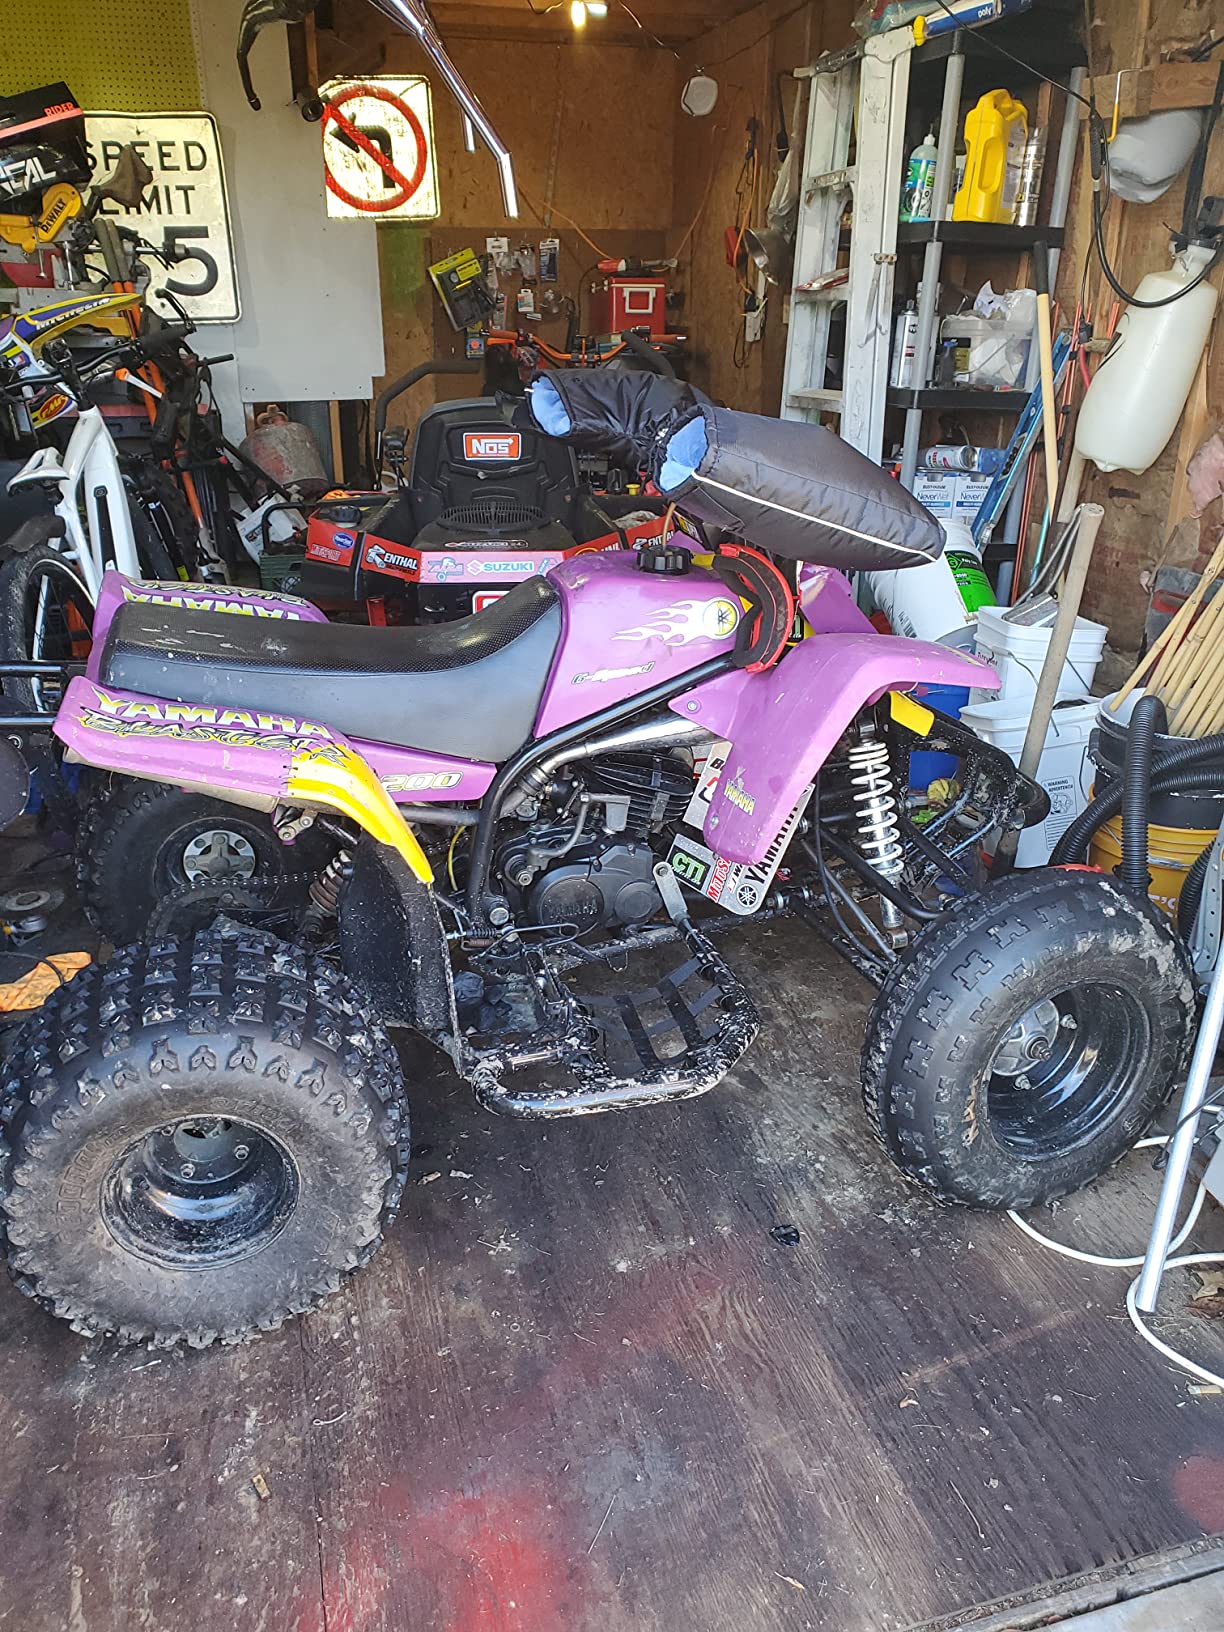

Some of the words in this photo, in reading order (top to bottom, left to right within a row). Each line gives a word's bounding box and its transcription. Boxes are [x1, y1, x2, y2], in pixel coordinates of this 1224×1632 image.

[44, 101, 75, 117] RIDER
[100, 184, 196, 216] MIT
[471, 438, 514, 454] NOS
[366, 544, 418, 570] RENTHAL
[483, 561, 534, 573] SUZUKI
[91, 684, 334, 741] YAMAHA
[380, 768, 464, 792] 200
[672, 852, 705, 883] CTI
